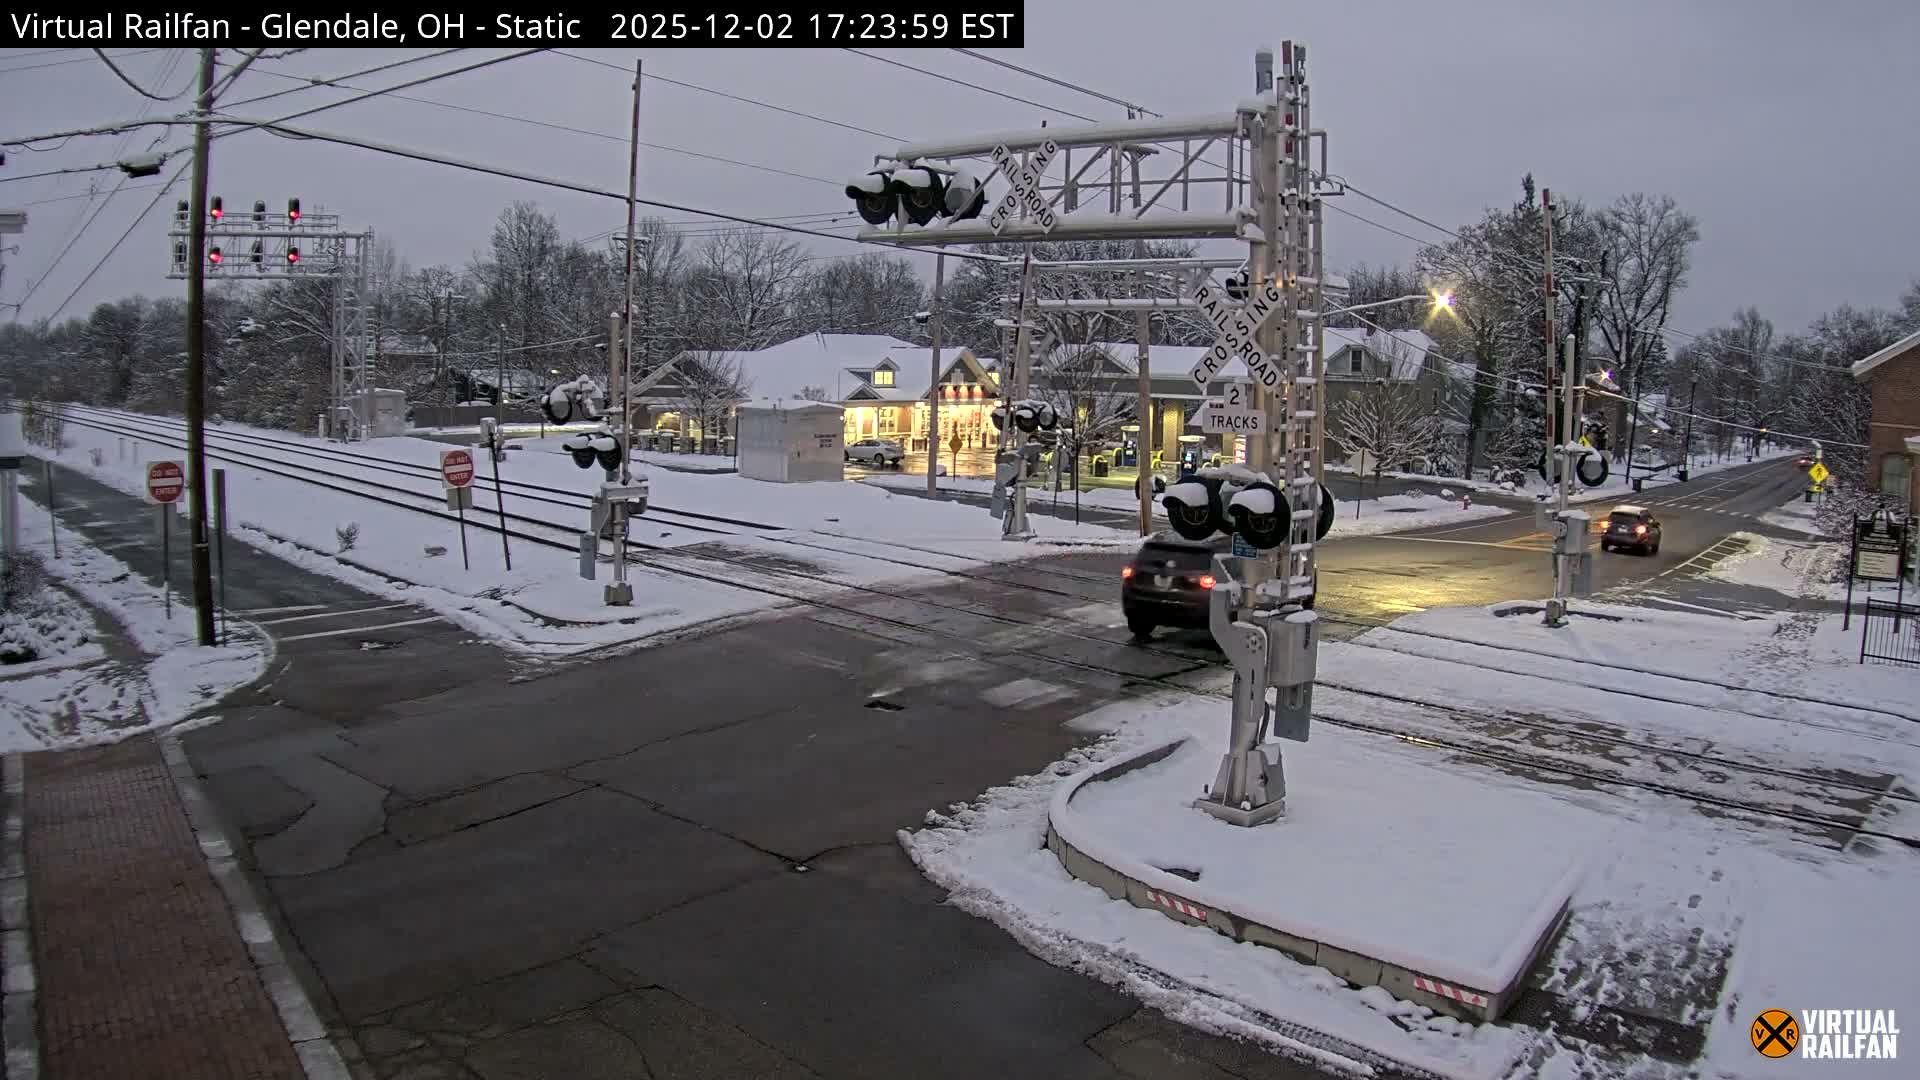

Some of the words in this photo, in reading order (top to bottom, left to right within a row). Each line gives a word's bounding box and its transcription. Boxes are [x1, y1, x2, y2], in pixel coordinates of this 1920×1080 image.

[991, 141, 1055, 229] CROSSING
[1194, 287, 1279, 384] CROSSING
[1229, 387, 1240, 405] 2
[1210, 415, 1258, 430] TRACKS
[449, 472, 468, 481] ENTER
[155, 486, 177, 497] ENTER
